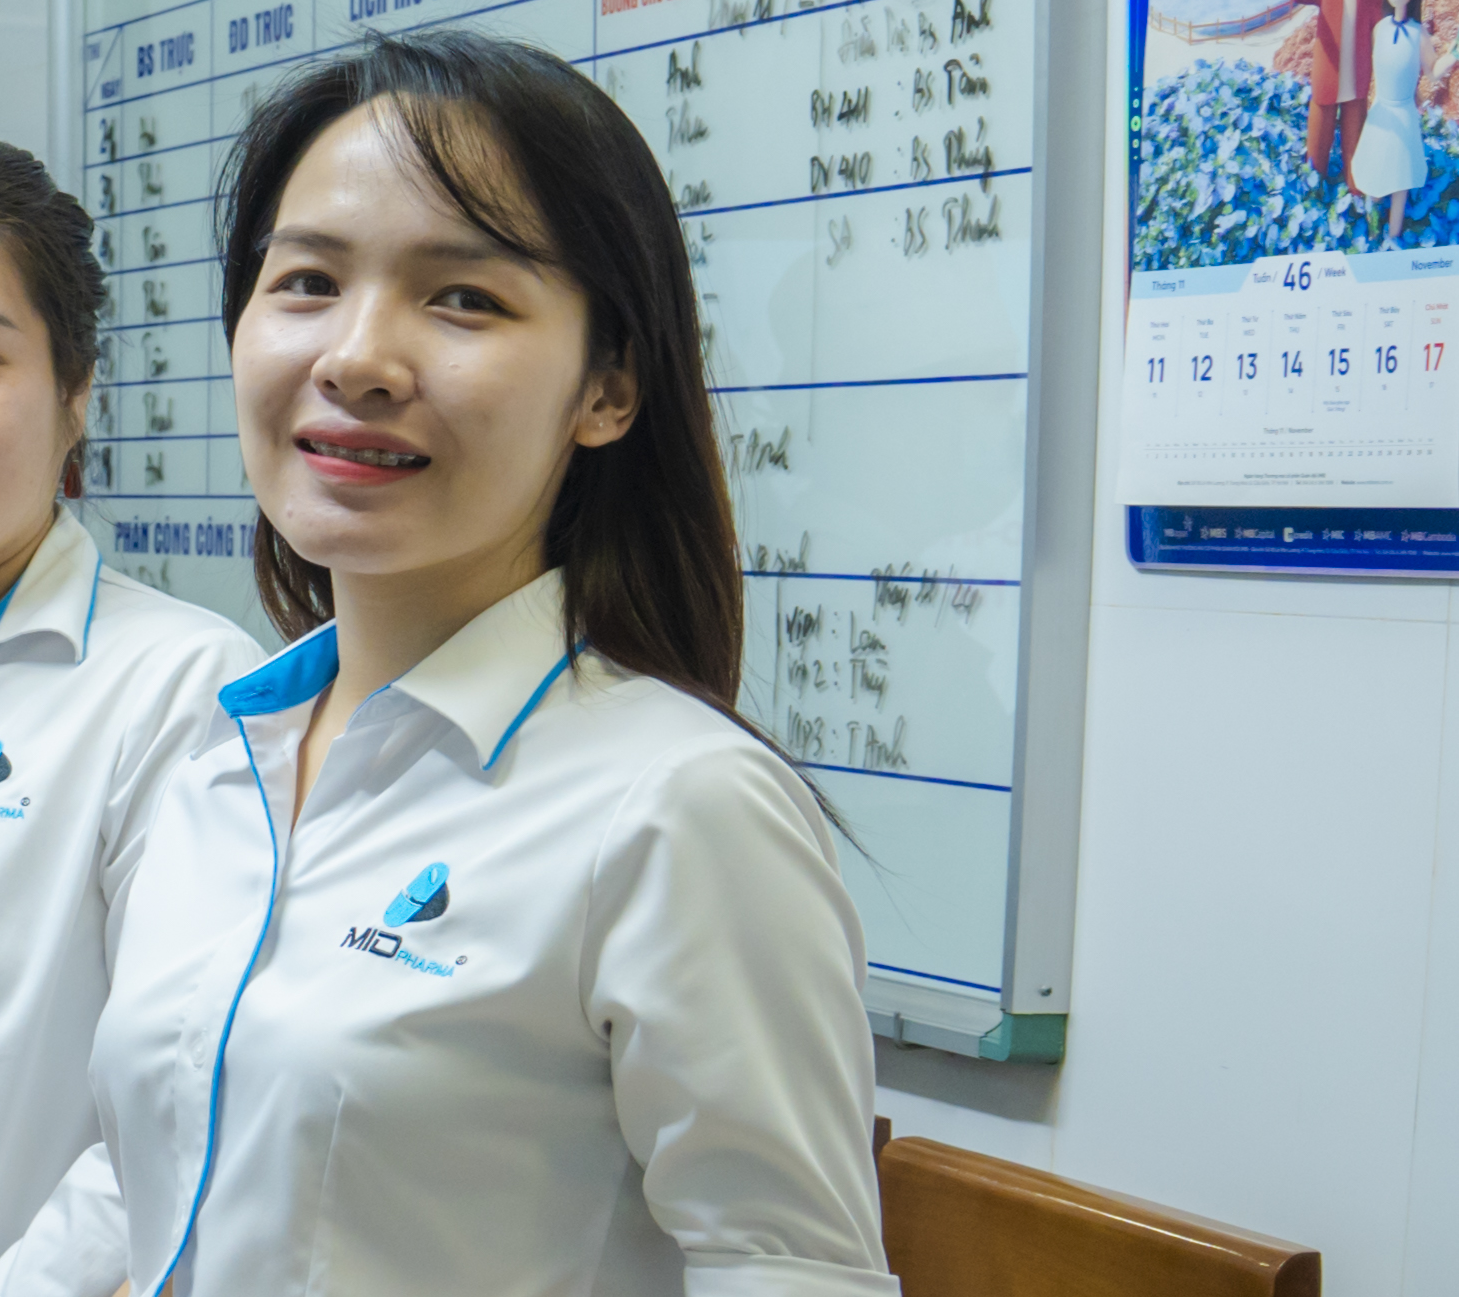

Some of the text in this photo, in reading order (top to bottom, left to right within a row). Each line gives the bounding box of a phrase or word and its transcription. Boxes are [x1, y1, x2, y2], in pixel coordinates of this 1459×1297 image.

[254, 3, 294, 50] TRỰC
[137, 43, 154, 79] BS
[1283, 260, 1312, 292] 46
[1324, 267, 1346, 278] Week
[1411, 258, 1454, 271] November
[1152, 280, 1176, 292] Tháng
[1147, 342, 1445, 383] 11 12 13 14 15 16 17
